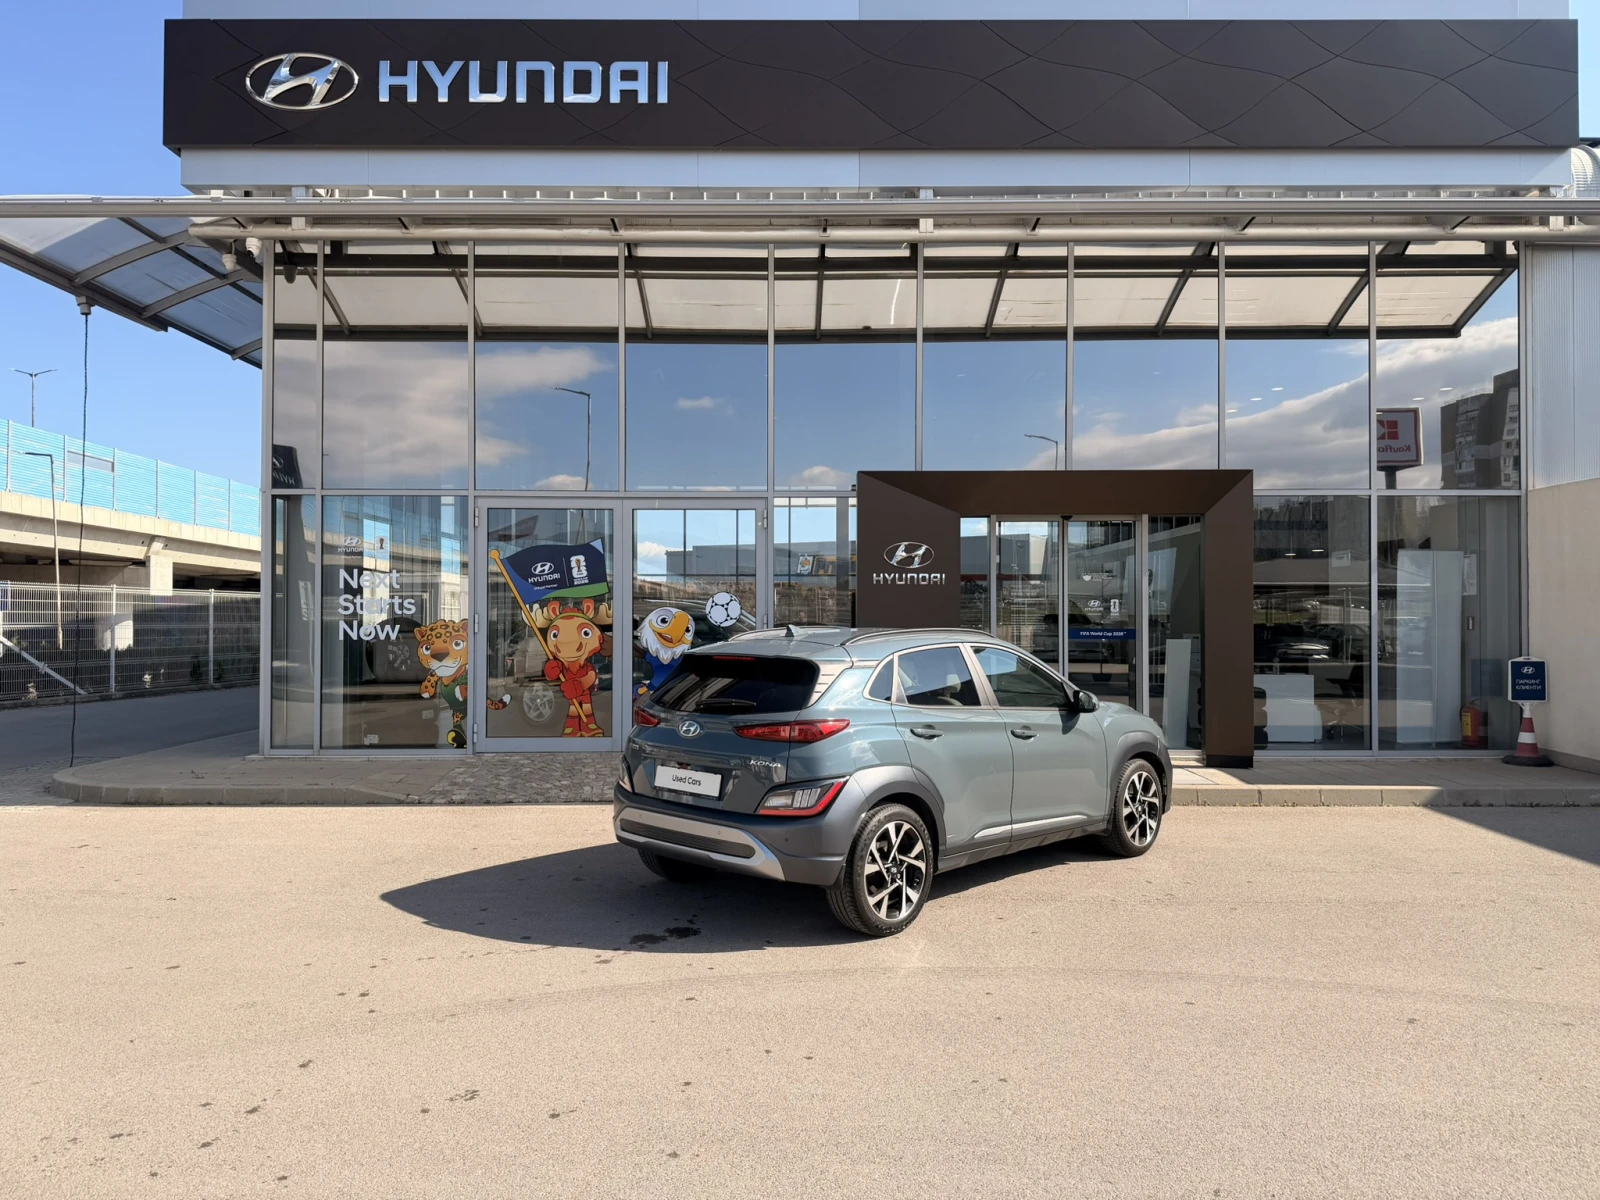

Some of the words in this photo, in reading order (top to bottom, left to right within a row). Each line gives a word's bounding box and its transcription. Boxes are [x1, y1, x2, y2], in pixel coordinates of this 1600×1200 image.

[378, 60, 669, 104] HYUNDAI
[339, 568, 400, 589] Next
[528, 572, 561, 583] HYUNDAI
[872, 573, 946, 585] HYUNDAI
[337, 594, 417, 615] Starts
[339, 620, 400, 641] Now
[749, 759, 781, 768] KONA
[671, 774, 687, 784] Used
[687, 776, 702, 786] Cars
